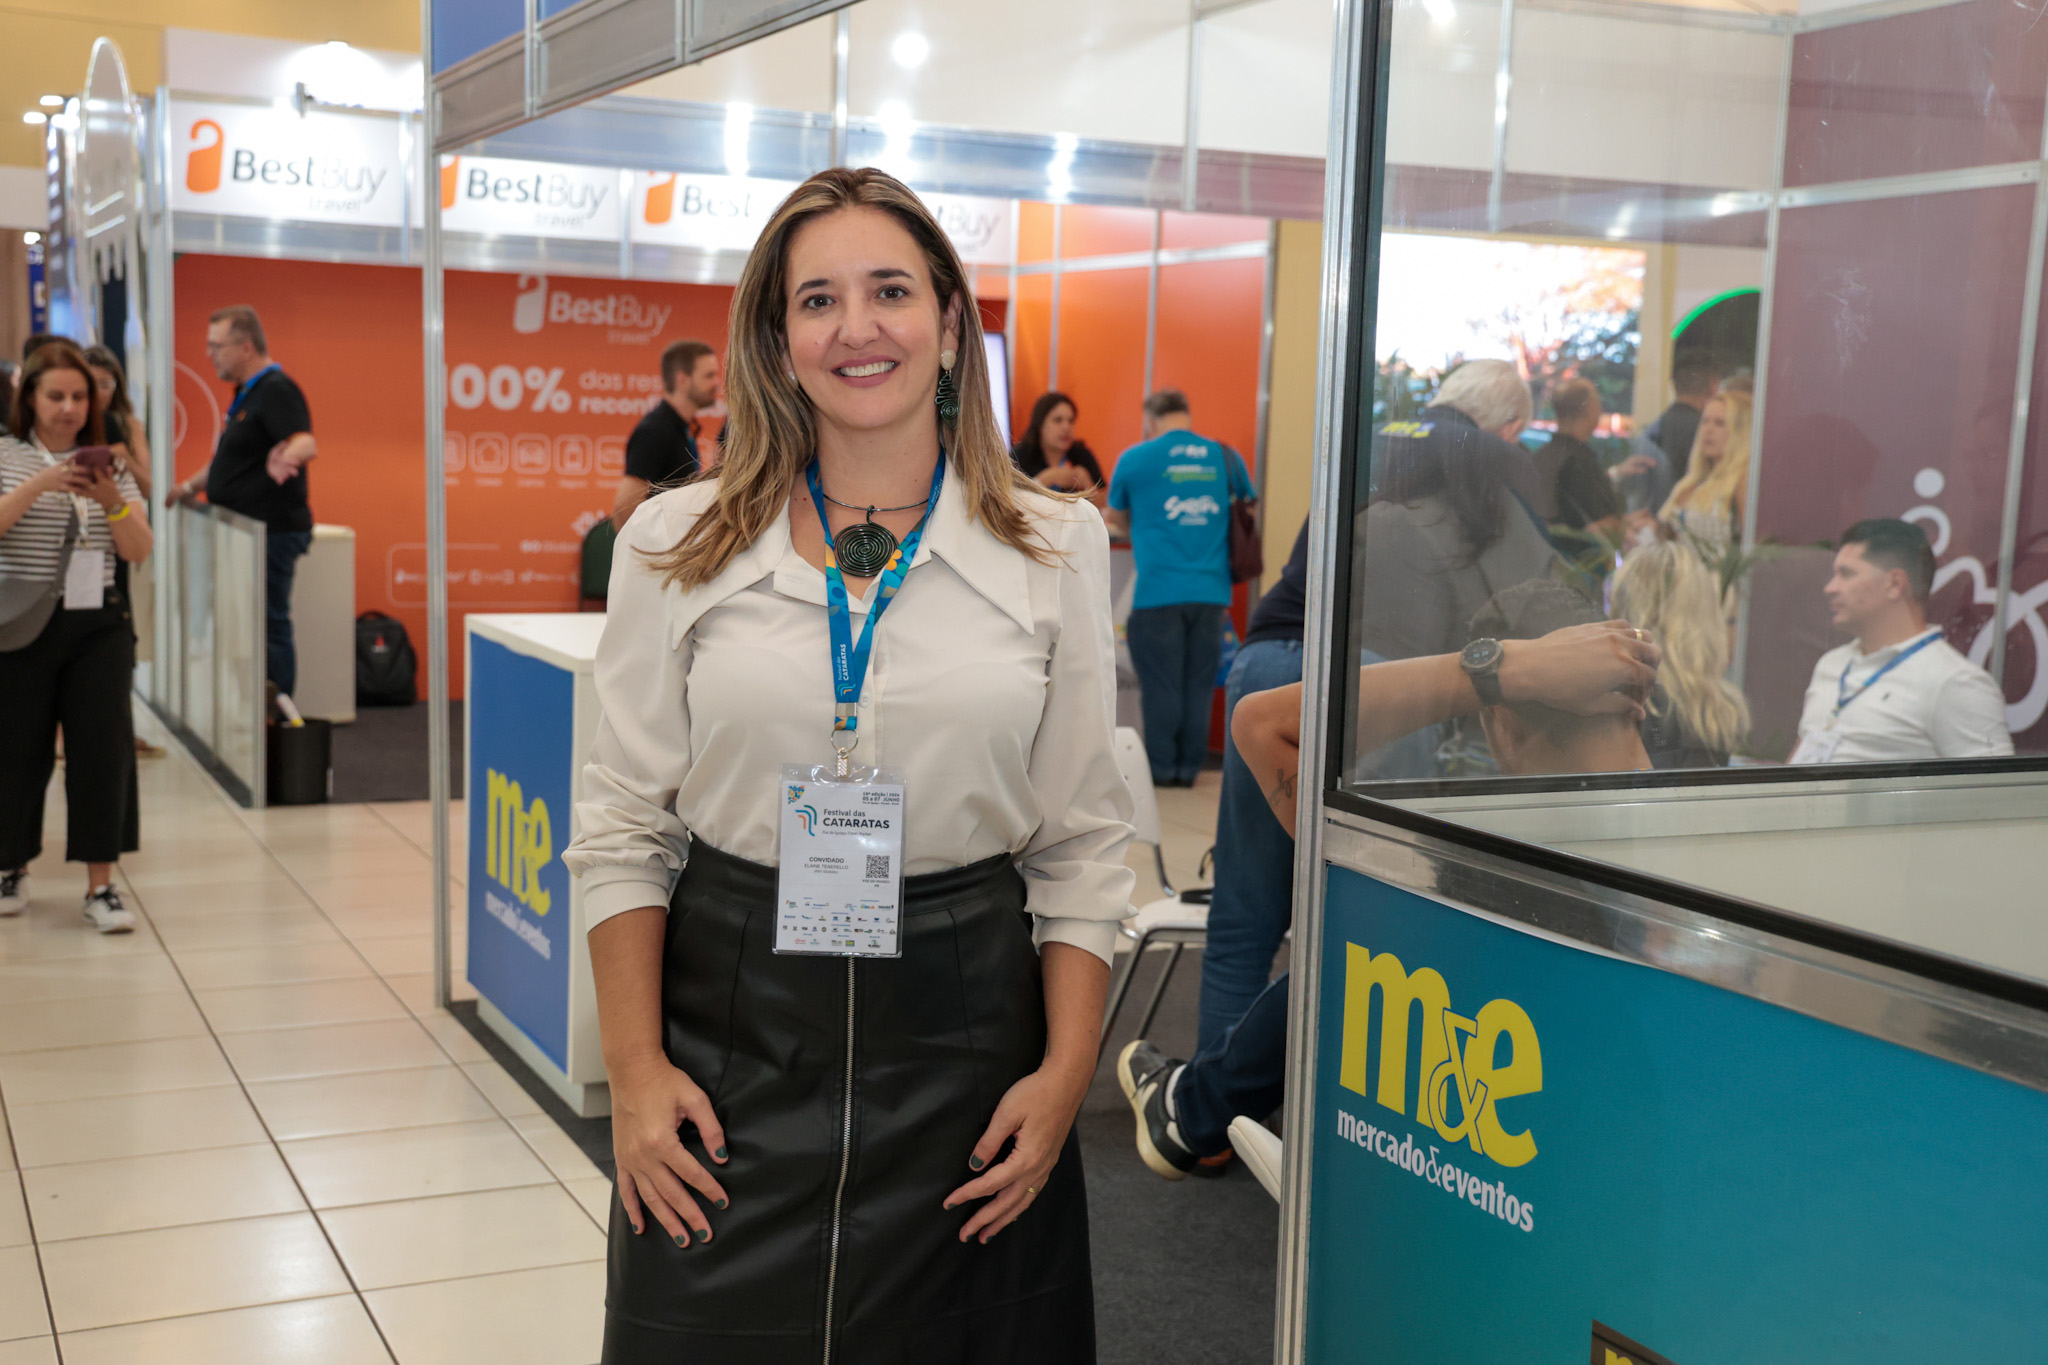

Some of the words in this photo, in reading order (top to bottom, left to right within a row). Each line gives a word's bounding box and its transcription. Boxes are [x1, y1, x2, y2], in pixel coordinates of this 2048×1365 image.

[233, 148, 388, 204] BestBuy
[467, 167, 609, 220] BestBuy
[682, 183, 751, 219] Best
[550, 290, 673, 338] BestBuy
[578, 369, 623, 392] das
[627, 373, 663, 393] res
[840, 644, 849, 681] CATARATAS
[823, 809, 852, 817] Festival
[823, 817, 890, 829] CATARATAS
[809, 856, 845, 864] CONVIDADO
[1339, 940, 1543, 1168] m&e
[1337, 1109, 1534, 1233] mercado&eventos
